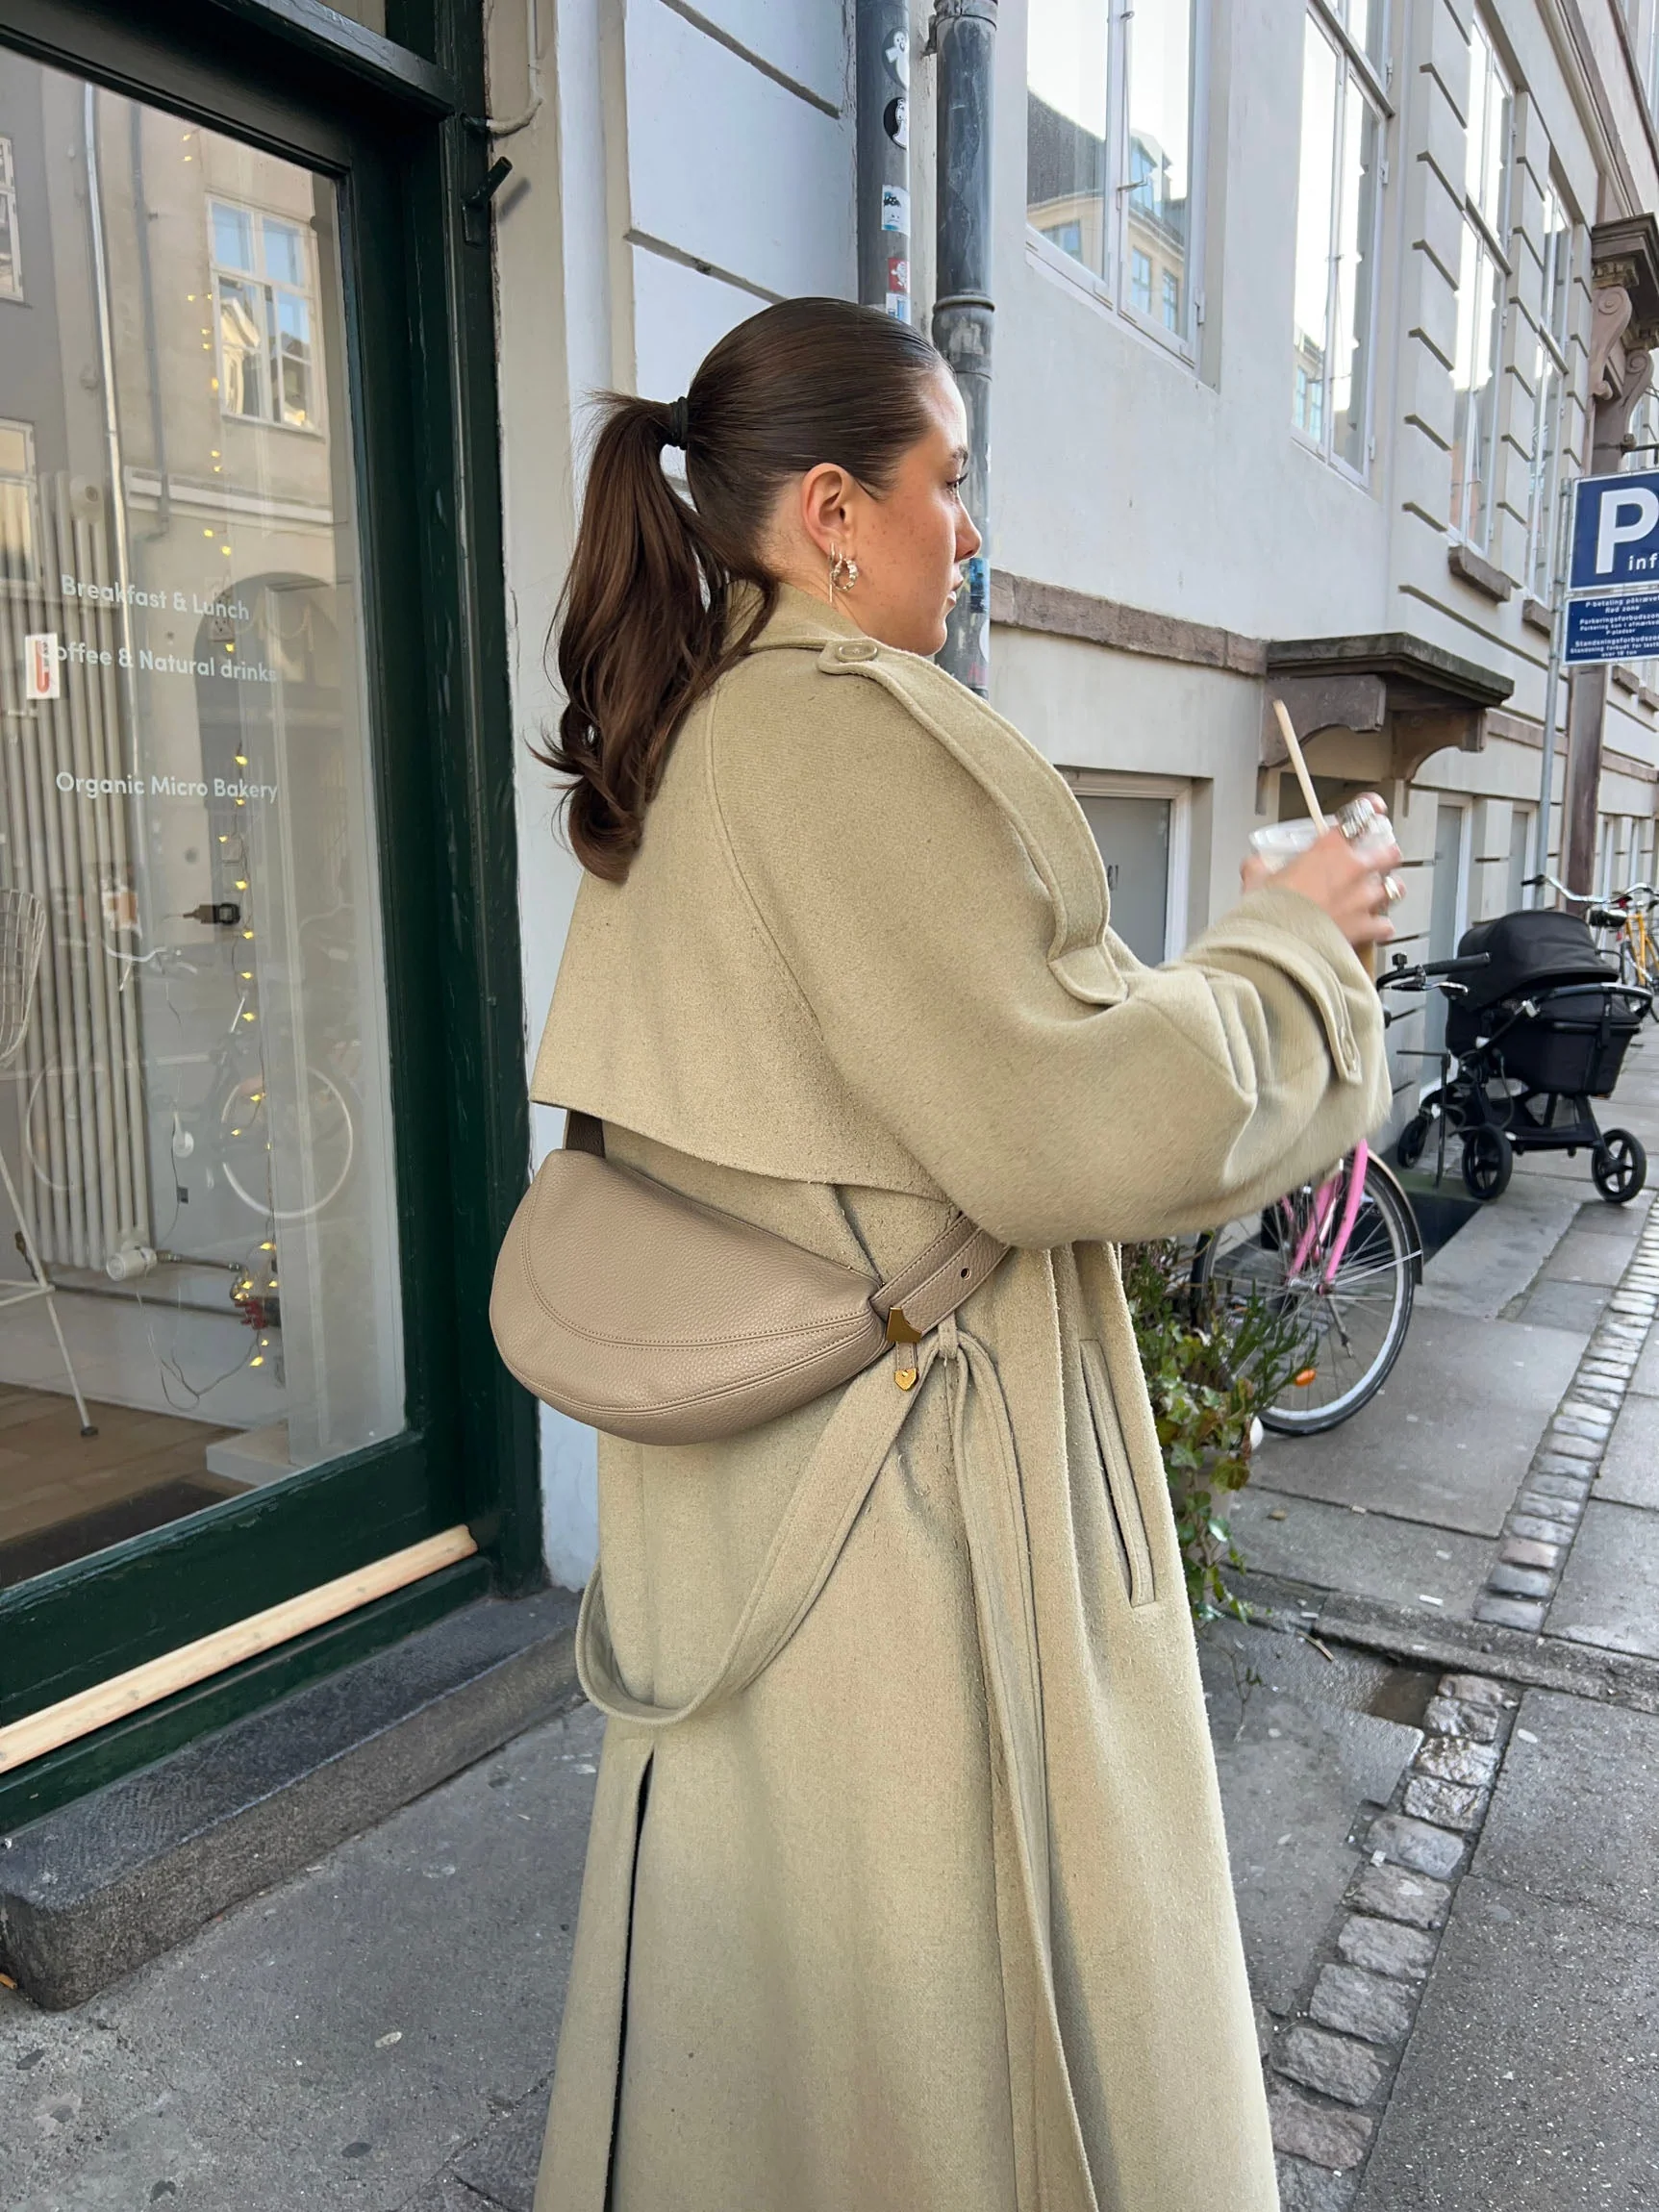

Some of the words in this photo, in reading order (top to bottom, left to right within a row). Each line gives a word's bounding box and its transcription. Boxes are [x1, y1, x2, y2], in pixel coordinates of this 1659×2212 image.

[1596, 488, 1659, 574] P
[61, 574, 166, 609] Breakfast
[173, 591, 188, 613] &
[192, 593, 250, 620] Lunch
[118, 646, 134, 667] &
[139, 649, 215, 676] Natural
[220, 659, 277, 682] drinks
[56, 771, 145, 799] Organic
[151, 775, 208, 797] Micro
[214, 778, 278, 804] Bakery
